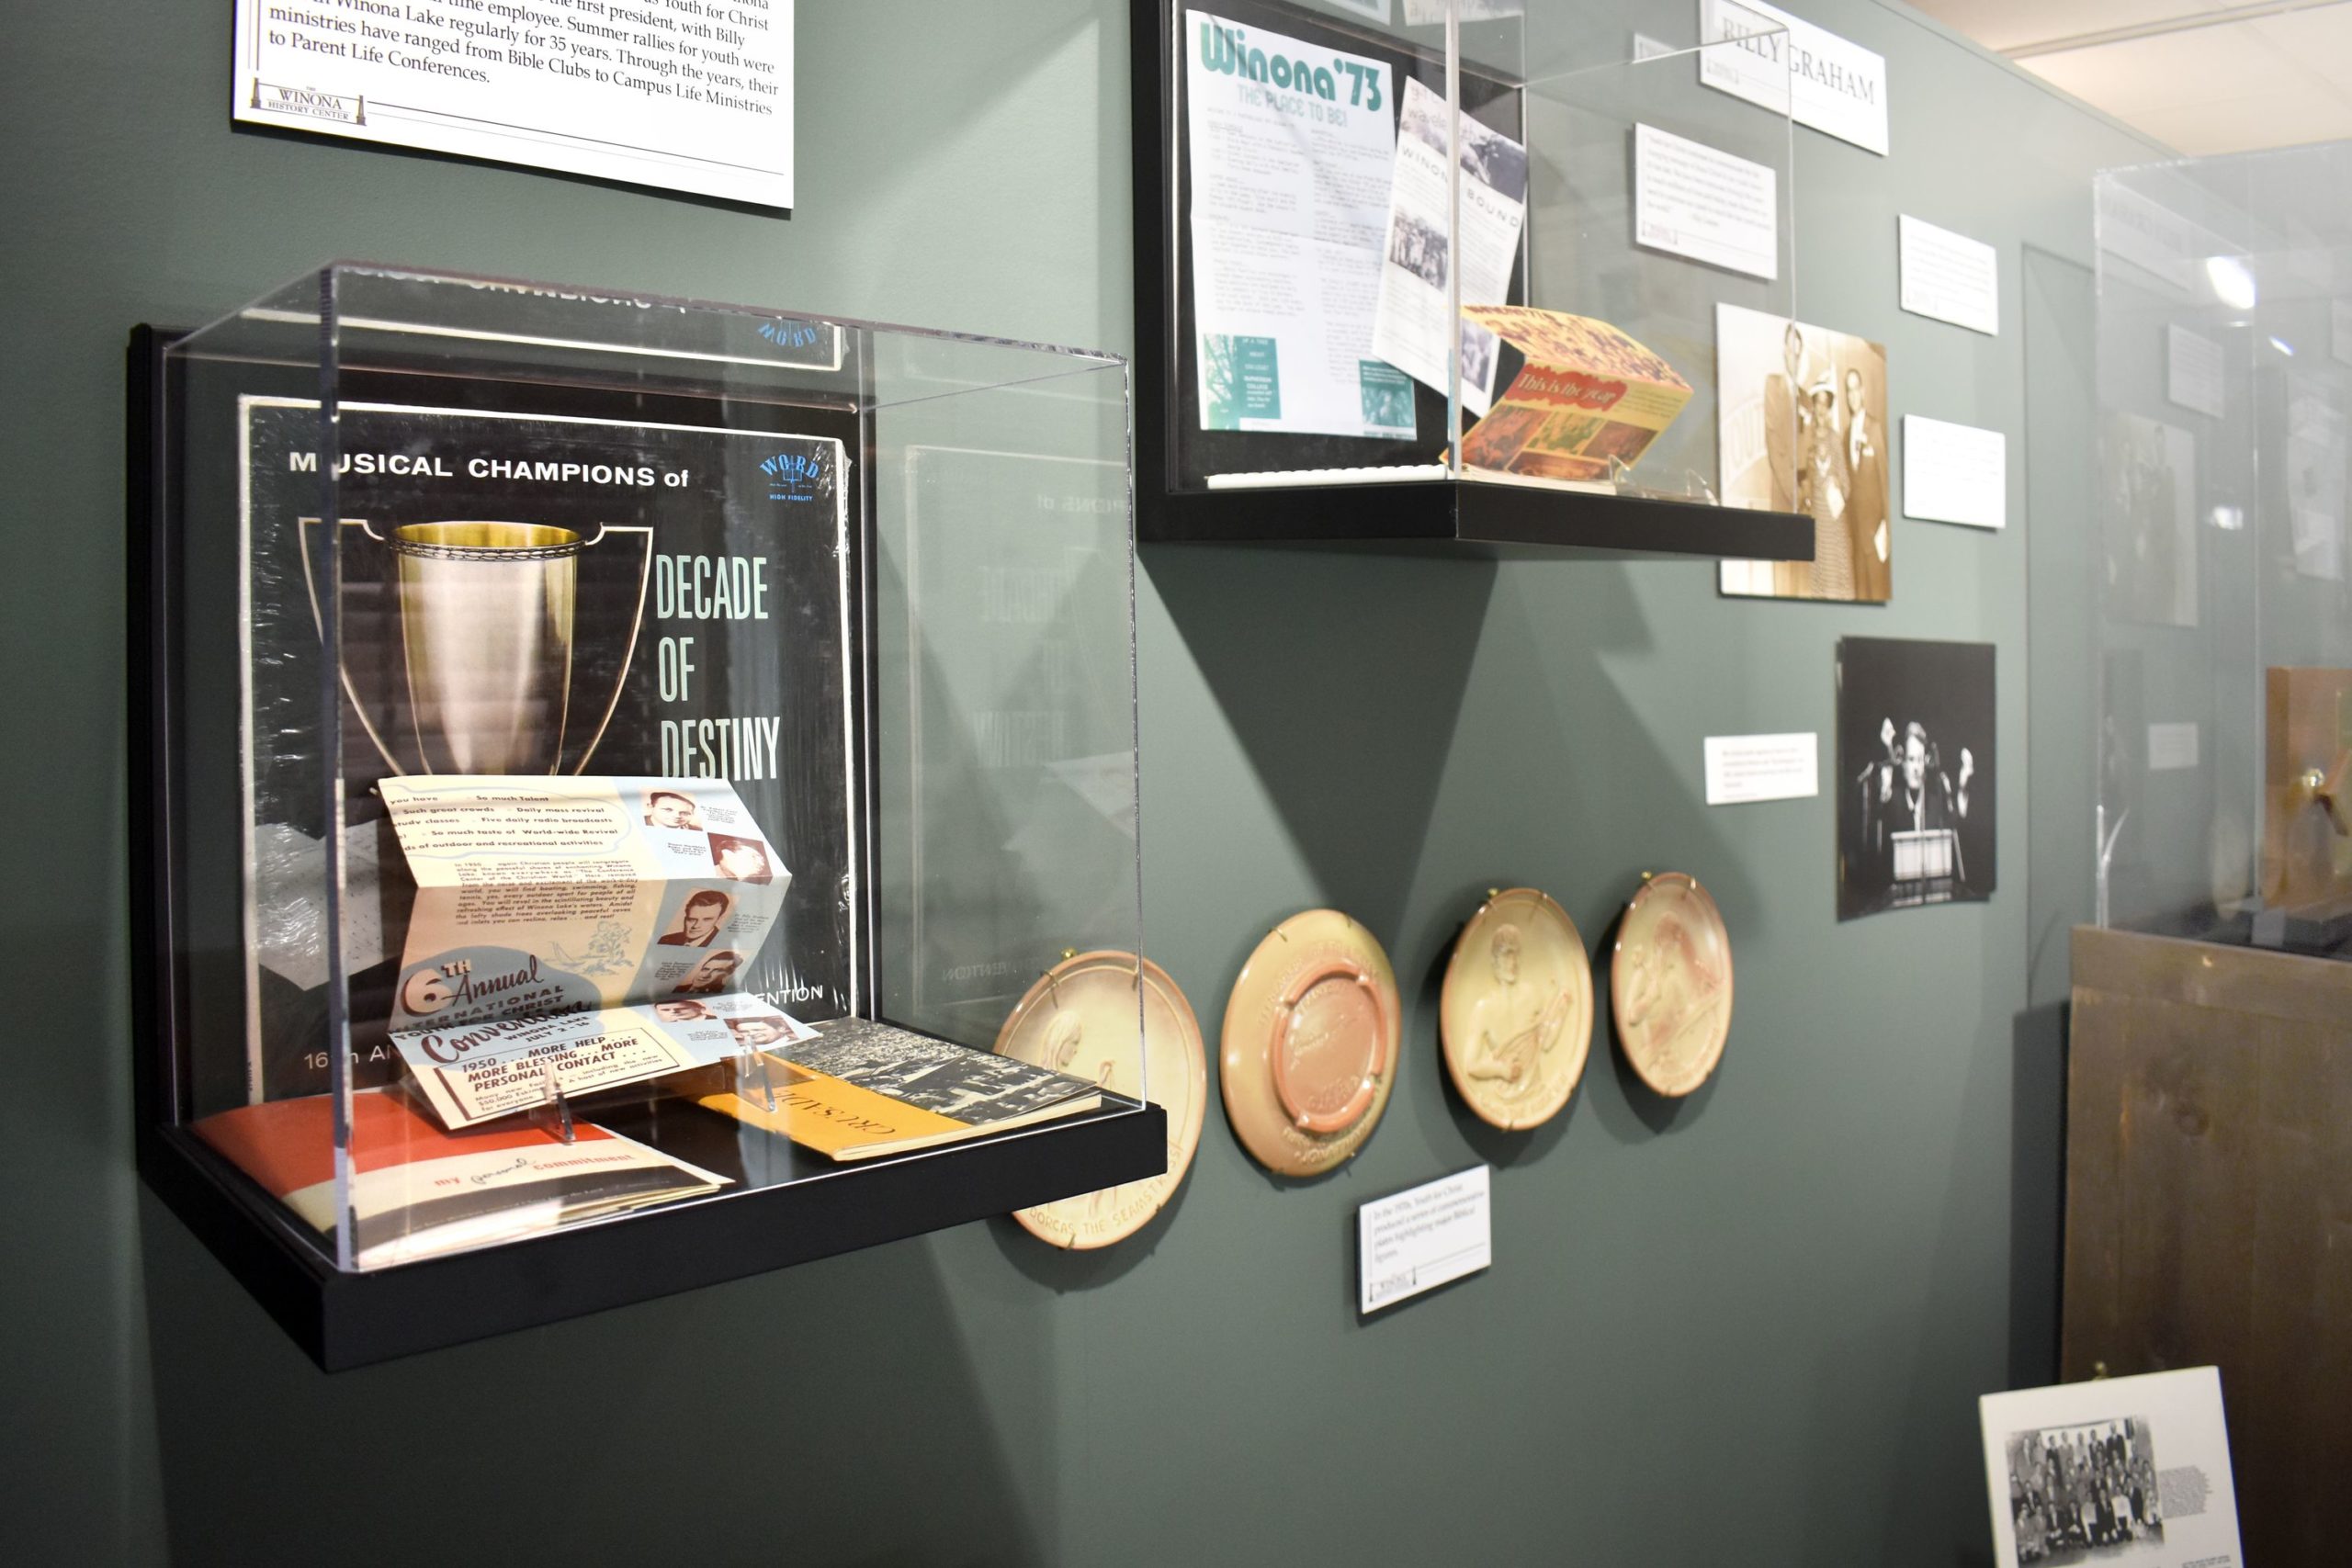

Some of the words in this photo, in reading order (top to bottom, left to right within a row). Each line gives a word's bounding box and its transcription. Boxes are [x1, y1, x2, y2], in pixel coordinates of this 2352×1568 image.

[577, 0, 605, 15] first
[609, 6, 677, 32] president,
[681, 19, 712, 39] with
[716, 26, 745, 51] Billy
[706, 3, 725, 20] for
[728, 9, 769, 30] Christ
[269, 29, 286, 46] to
[291, 31, 346, 57] Parent
[352, 45, 384, 64] Life
[388, 50, 491, 84] Conferences.
[336, 0, 401, 18] Winona
[406, 5, 445, 28] Lake
[449, 17, 520, 44] regularly
[525, 29, 546, 47] for
[549, 35, 567, 51] 35
[571, 41, 613, 62] years.
[616, 48, 678, 77] Through
[682, 63, 703, 80] the
[707, 69, 744, 90] years,
[748, 77, 779, 96] their
[487, 4, 563, 29] employee.
[567, 16, 629, 43] Summer
[633, 31, 675, 53] rallies
[678, 39, 698, 58] for
[701, 45, 740, 67] youth
[743, 58, 775, 74] were
[269, 6, 356, 35] ministries
[361, 17, 401, 42] have
[404, 31, 460, 55] ranged
[465, 38, 503, 62] from
[508, 48, 544, 71] Bible
[548, 57, 591, 80] Clubs
[595, 68, 609, 83] to
[613, 70, 673, 96] Campus
[676, 83, 702, 102] Life
[706, 88, 773, 117] Ministries
[1722, 17, 1780, 63] BILLY
[1788, 42, 1876, 106] GRAHAM
[267, 100, 309, 116] HISTORY
[311, 107, 349, 121] CENTER
[278, 88, 343, 110] WINONA
[1236, 83, 1261, 105] THE
[1309, 102, 1325, 123] TO
[1402, 145, 1449, 184] WINON
[1466, 187, 1520, 228] BOUND
[1517, 372, 1546, 392] This
[1546, 379, 1560, 395] is
[1561, 381, 1581, 397] the
[288, 451, 453, 479] MUSICAL
[468, 457, 656, 488] CHAMPIONS
[663, 468, 690, 489] of
[759, 454, 820, 479] WORD
[787, 494, 813, 502] FIDELITY
[655, 553, 769, 620] DECADE
[658, 637, 695, 703] OF
[661, 716, 781, 781] DESTINY
[403, 807, 427, 815] Such
[430, 807, 458, 815] great
[441, 953, 545, 1008] Annual
[753, 984, 824, 1006] ENTION
[395, 985, 565, 1032] TERNATIONAL
[503, 995, 565, 1015] CHRIST
[504, 1024, 555, 1041] WINONA
[560, 1016, 590, 1025] LAKE
[525, 1031, 553, 1043] JULY
[461, 1057, 497, 1073] 1950
[527, 1043, 567, 1058] MORE
[575, 1036, 606, 1049] HELP
[468, 1066, 508, 1083] MORE
[515, 1050, 578, 1071] BLESSING
[601, 1038, 639, 1053] MORE
[473, 1067, 546, 1092] PERSONAL
[556, 1051, 616, 1072] CONTACT
[434, 1176, 461, 1187] my
[470, 1157, 537, 1185] personal
[533, 1153, 636, 1171] commitment
[1029, 1206, 1075, 1236] DORCAS
[1083, 1220, 1105, 1235] THE
[1113, 1149, 1182, 1227] SEAMSTRSS
